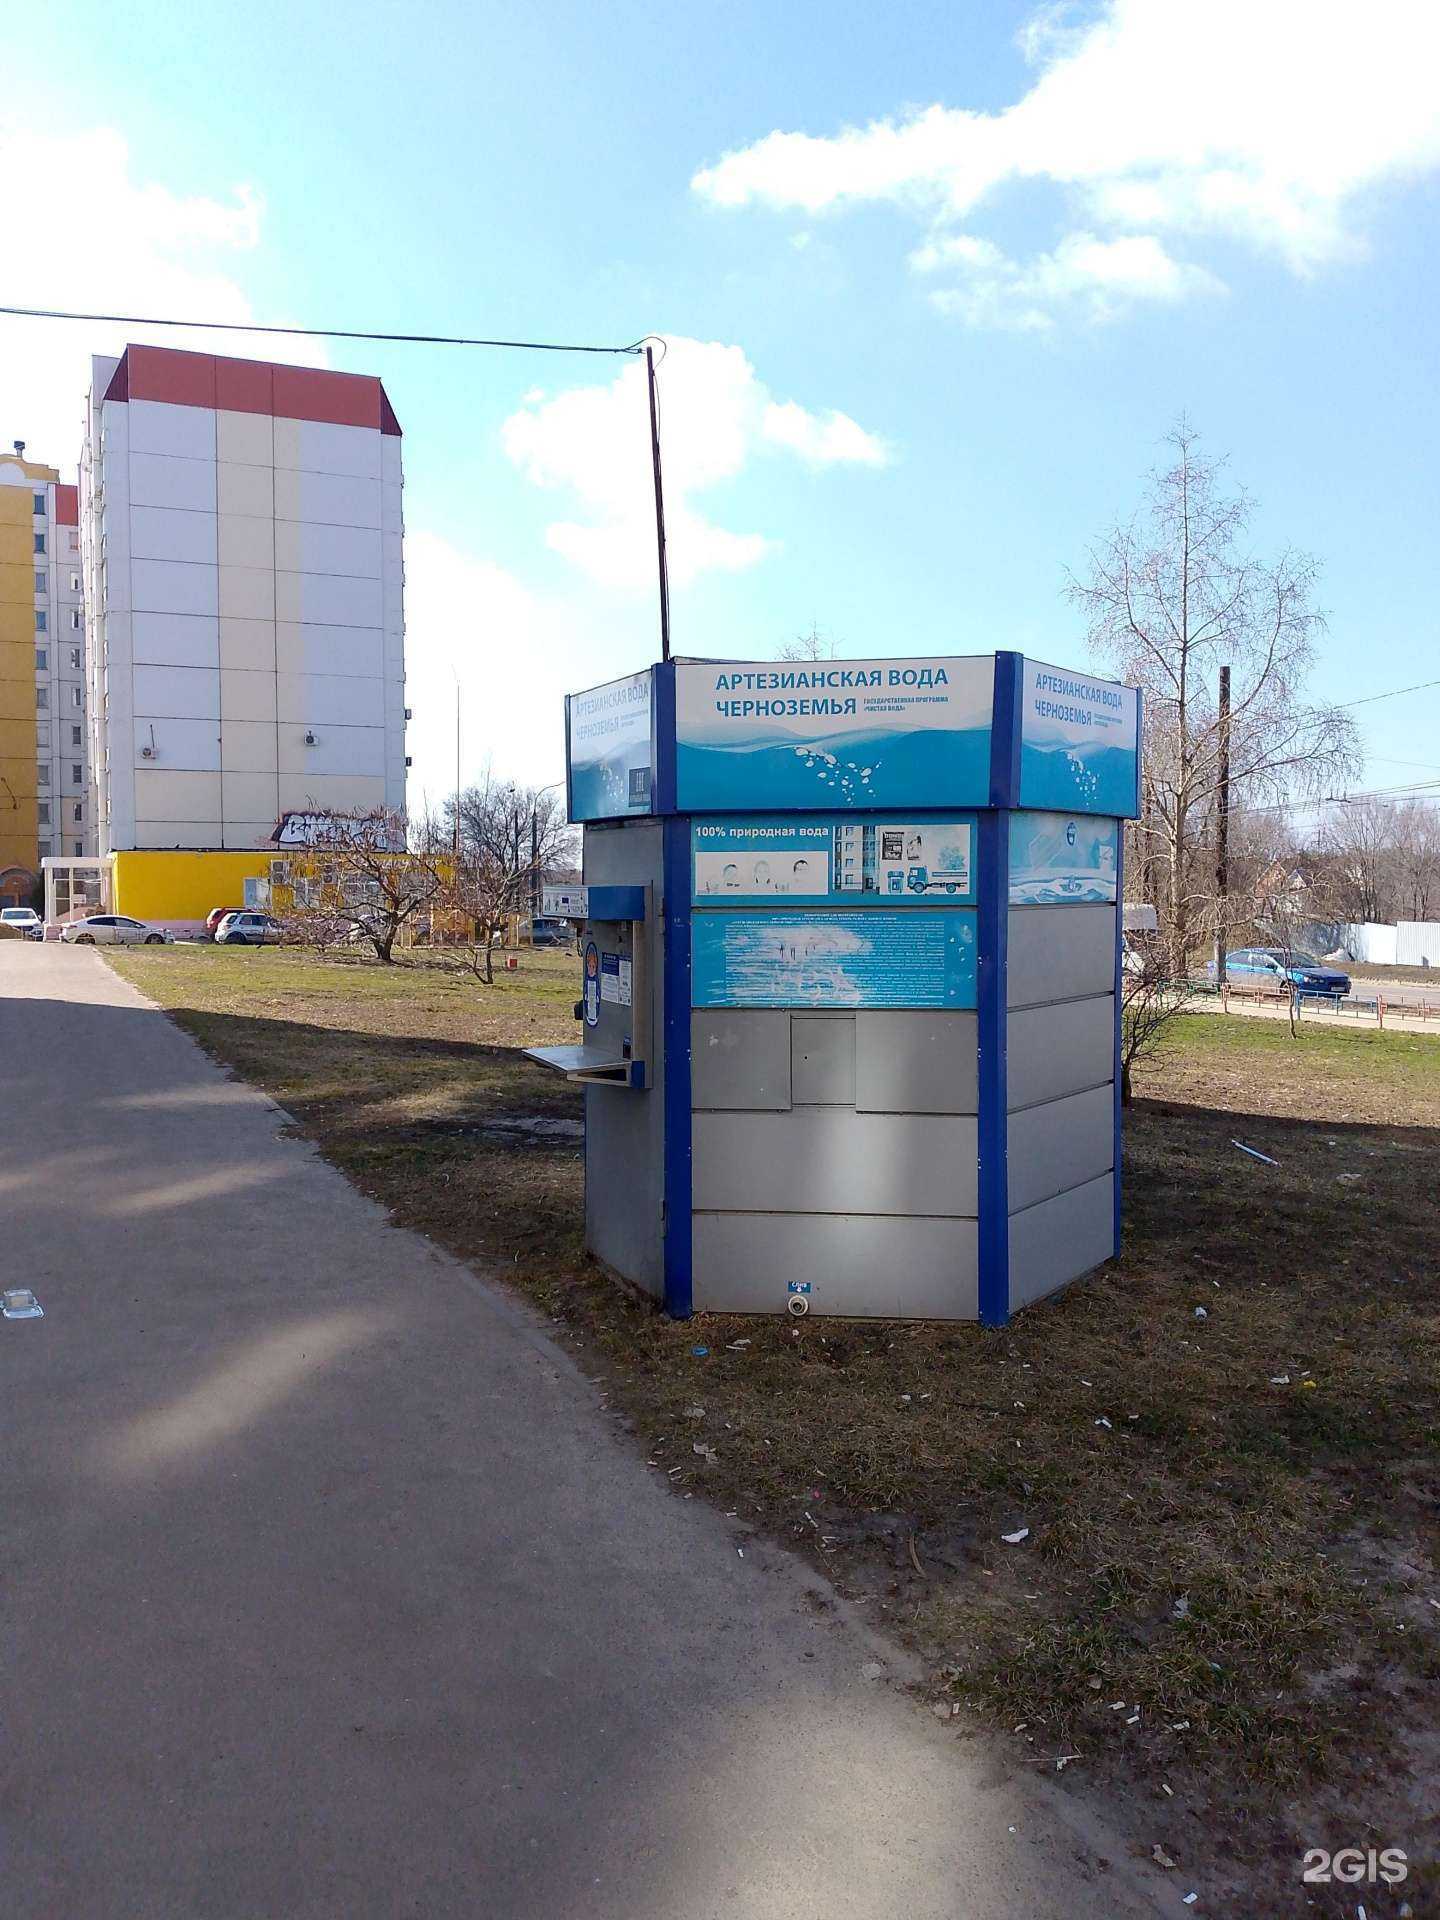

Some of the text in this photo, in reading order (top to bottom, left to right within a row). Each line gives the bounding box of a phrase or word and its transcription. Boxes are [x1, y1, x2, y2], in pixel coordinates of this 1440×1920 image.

[715, 668, 949, 690] АРТЕЗИАНСКАЯ ВОДА
[1035, 672, 1123, 710] АРТЕЗИАНСКАЯ ВОДА
[576, 690, 628, 718] АРТЕЗИАНСКАЯ
[628, 682, 649, 704] ВОДА
[715, 697, 857, 717] ЧЕРНОЗЕМЬЯ
[1034, 699, 1092, 726] ЧЕРНОЗЕМЬЯ
[576, 716, 620, 740] ЧЕРНОЗЕМЬЯ
[695, 826, 829, 838] 100% природная вода
